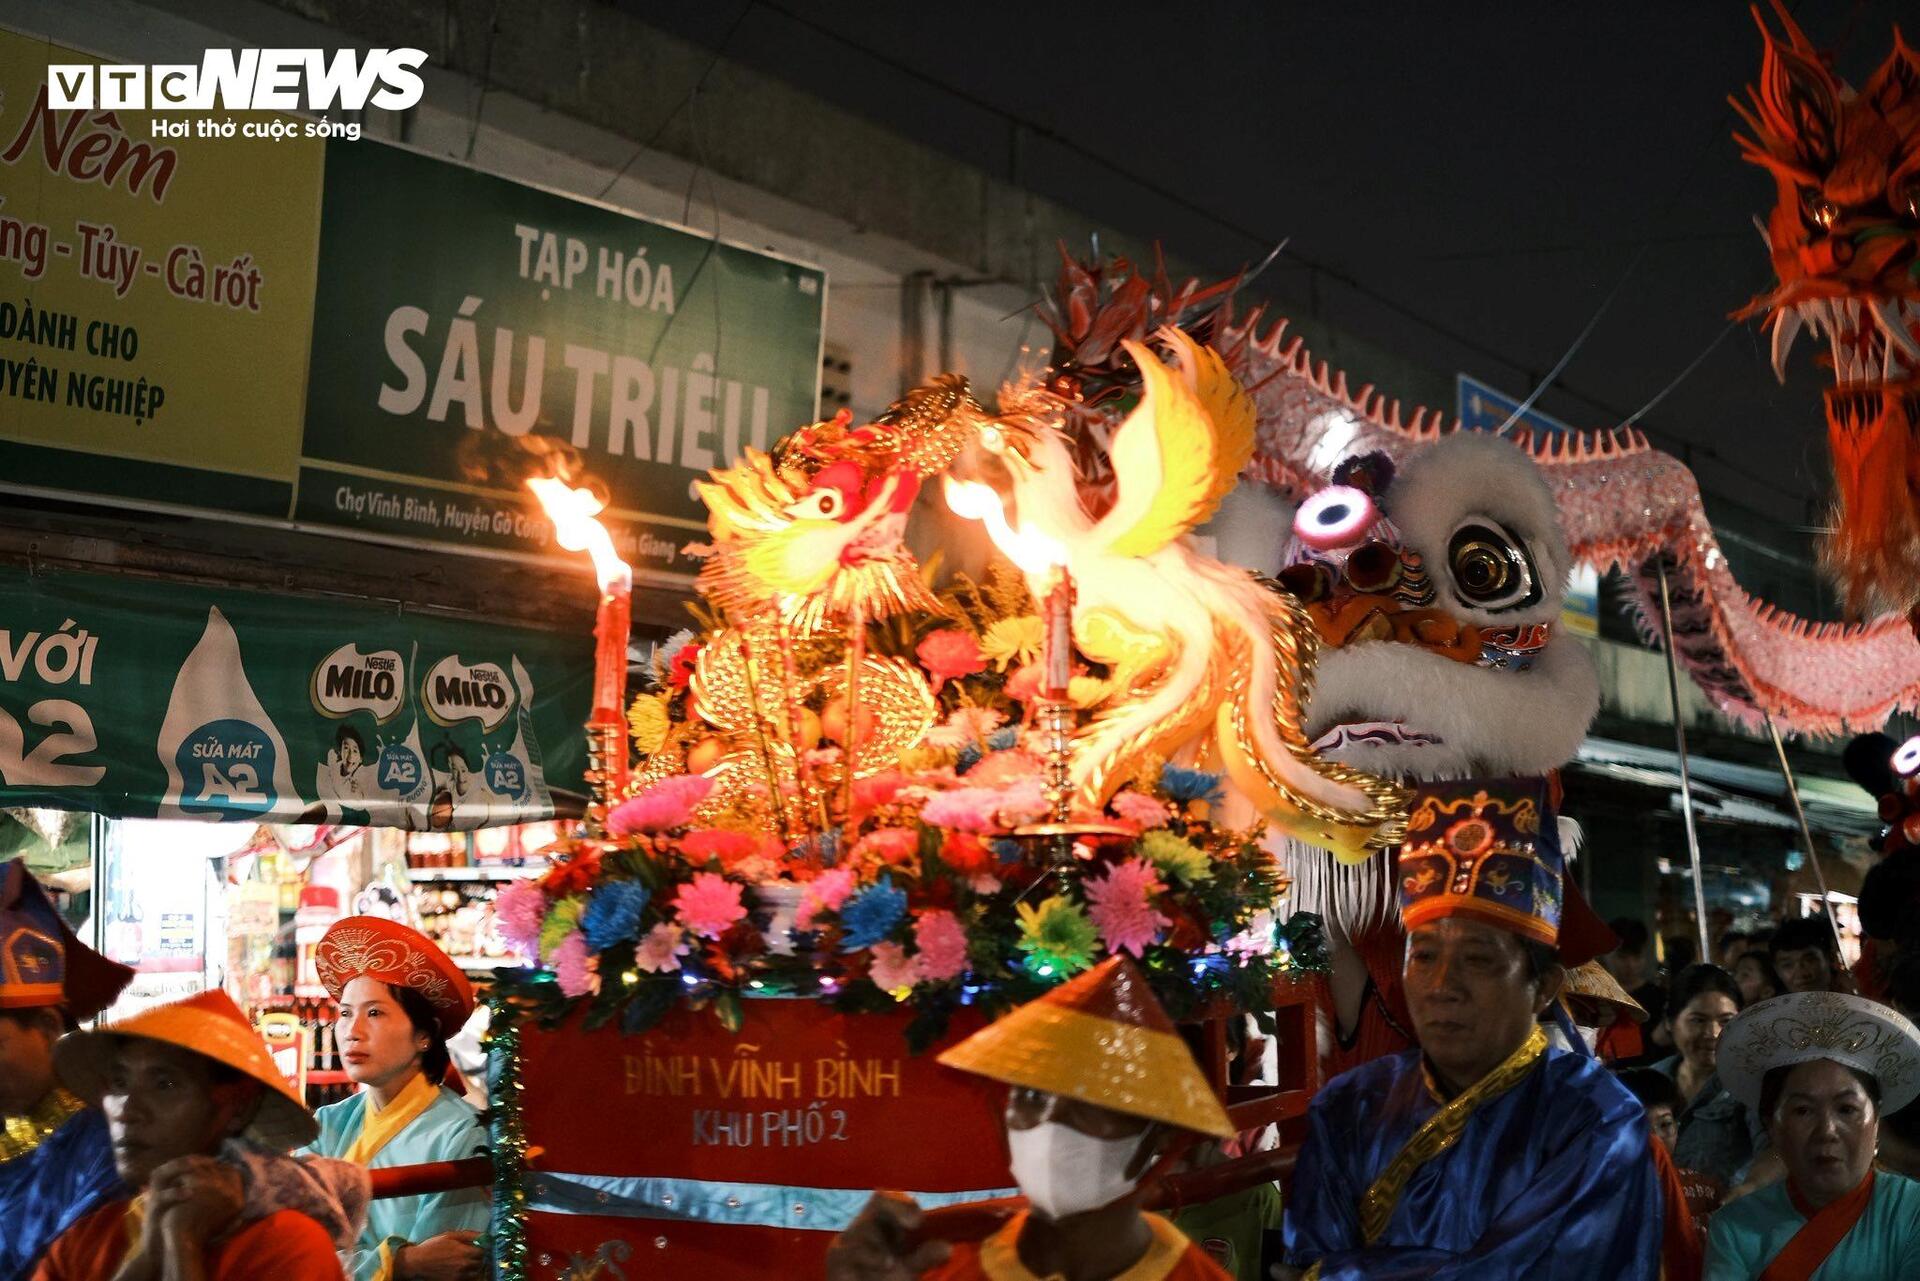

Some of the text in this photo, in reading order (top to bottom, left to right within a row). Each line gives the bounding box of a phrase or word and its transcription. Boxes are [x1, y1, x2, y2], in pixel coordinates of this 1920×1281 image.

[2, 84, 177, 202] Nêm
[0, 218, 47, 277] ng
[78, 224, 140, 296] Tủy
[167, 247, 206, 300] Cà
[214, 256, 262, 310] rốt
[514, 222, 675, 316] TẠP HÓA
[0, 298, 139, 362] DÀNH CHO
[0, 356, 166, 427] YÊN NGHIỆP
[377, 295, 546, 438] SÁU
[335, 485, 367, 521] Chợ
[443, 503, 491, 538] Huyện
[638, 533, 677, 565] Giang
[0, 617, 100, 686] VỚI
[325, 664, 396, 701] MILO
[435, 675, 507, 710] MILO
[191, 736, 263, 760] SỮA MÁT
[384, 761, 416, 783] A2
[195, 763, 268, 804] A2
[494, 770, 522, 790] A2
[708, 1042, 801, 1100] VĨNH
[815, 1039, 900, 1099] BÌNH
[691, 1100, 850, 1148] KHU PHỐ 2
